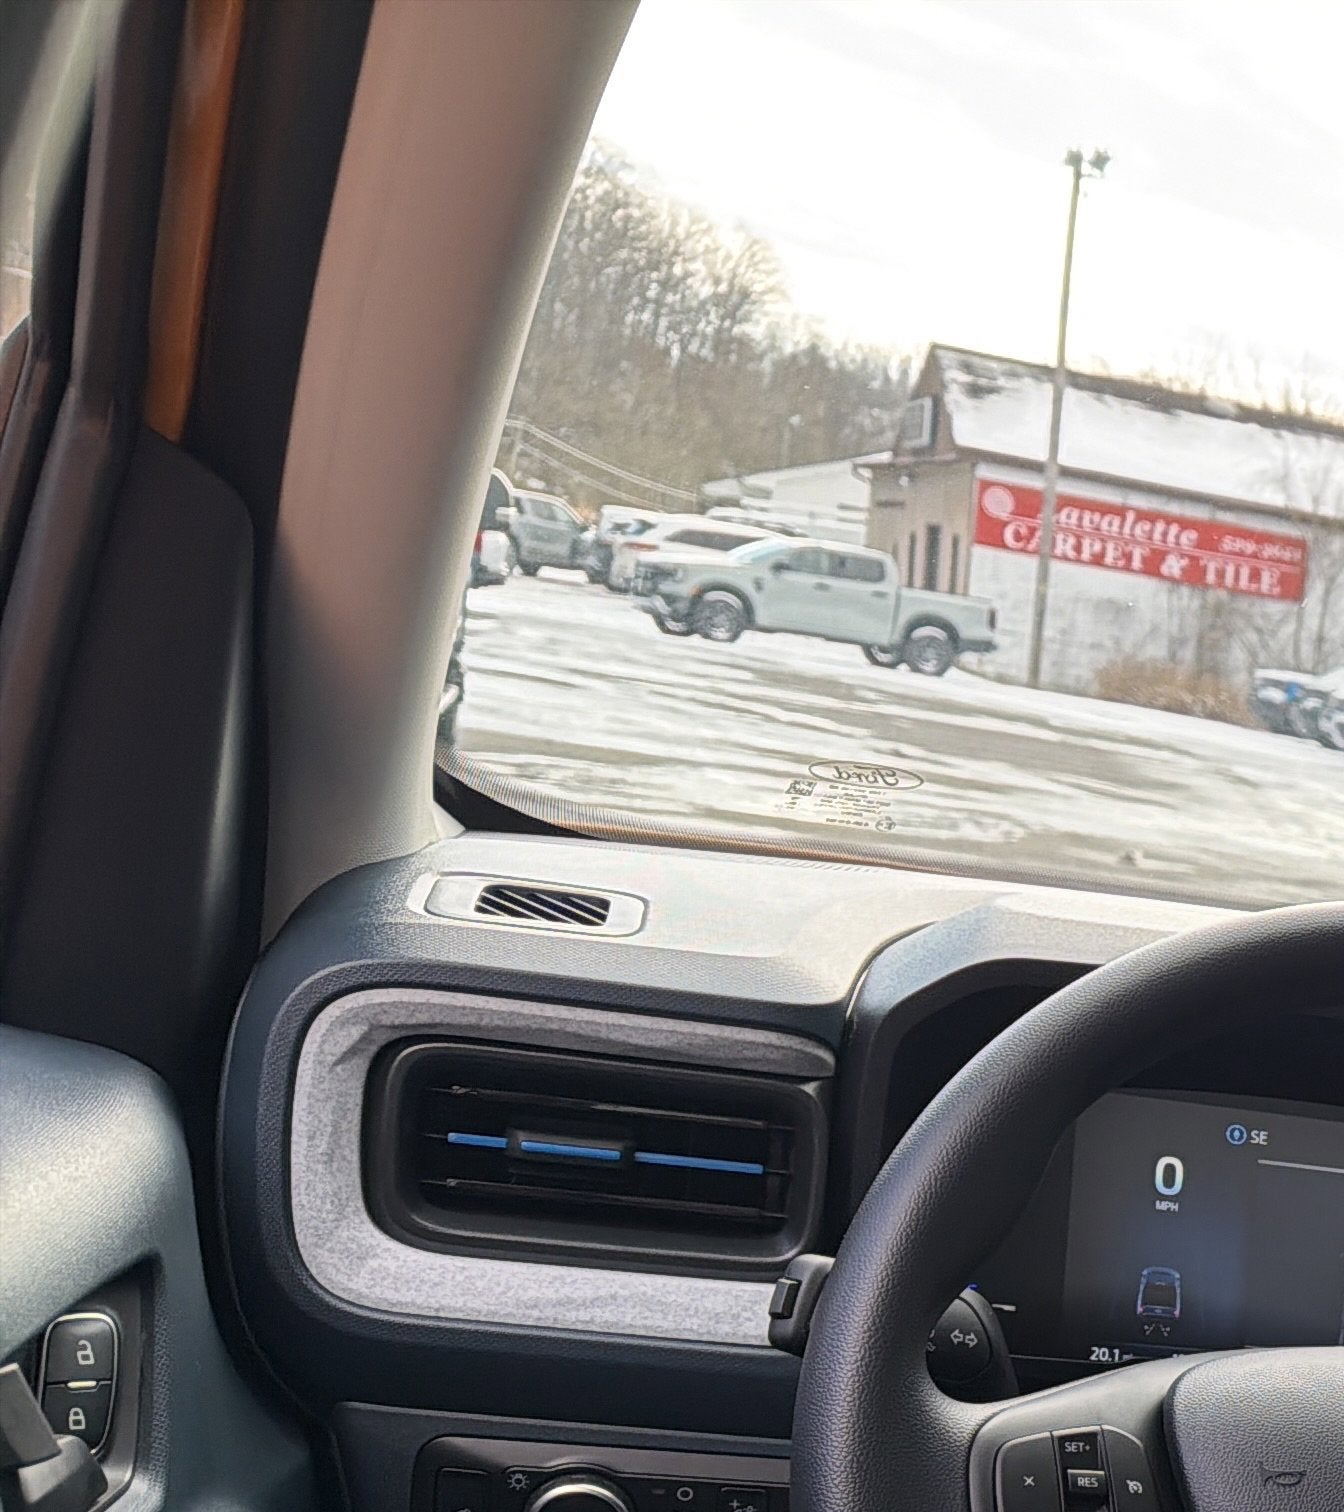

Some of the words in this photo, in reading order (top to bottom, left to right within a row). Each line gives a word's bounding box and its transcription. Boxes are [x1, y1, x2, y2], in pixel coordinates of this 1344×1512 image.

[1037, 505, 1198, 548] avalette
[1159, 552, 1190, 580] &
[1203, 560, 1280, 595] TILE
[1250, 1130, 1268, 1145] SE
[1154, 1155, 1184, 1196] 0
[1155, 1200, 1179, 1212] MPH
[1089, 1346, 1120, 1362] 20.1
[1064, 1441, 1090, 1453] SET+
[1077, 1476, 1098, 1488] RES
